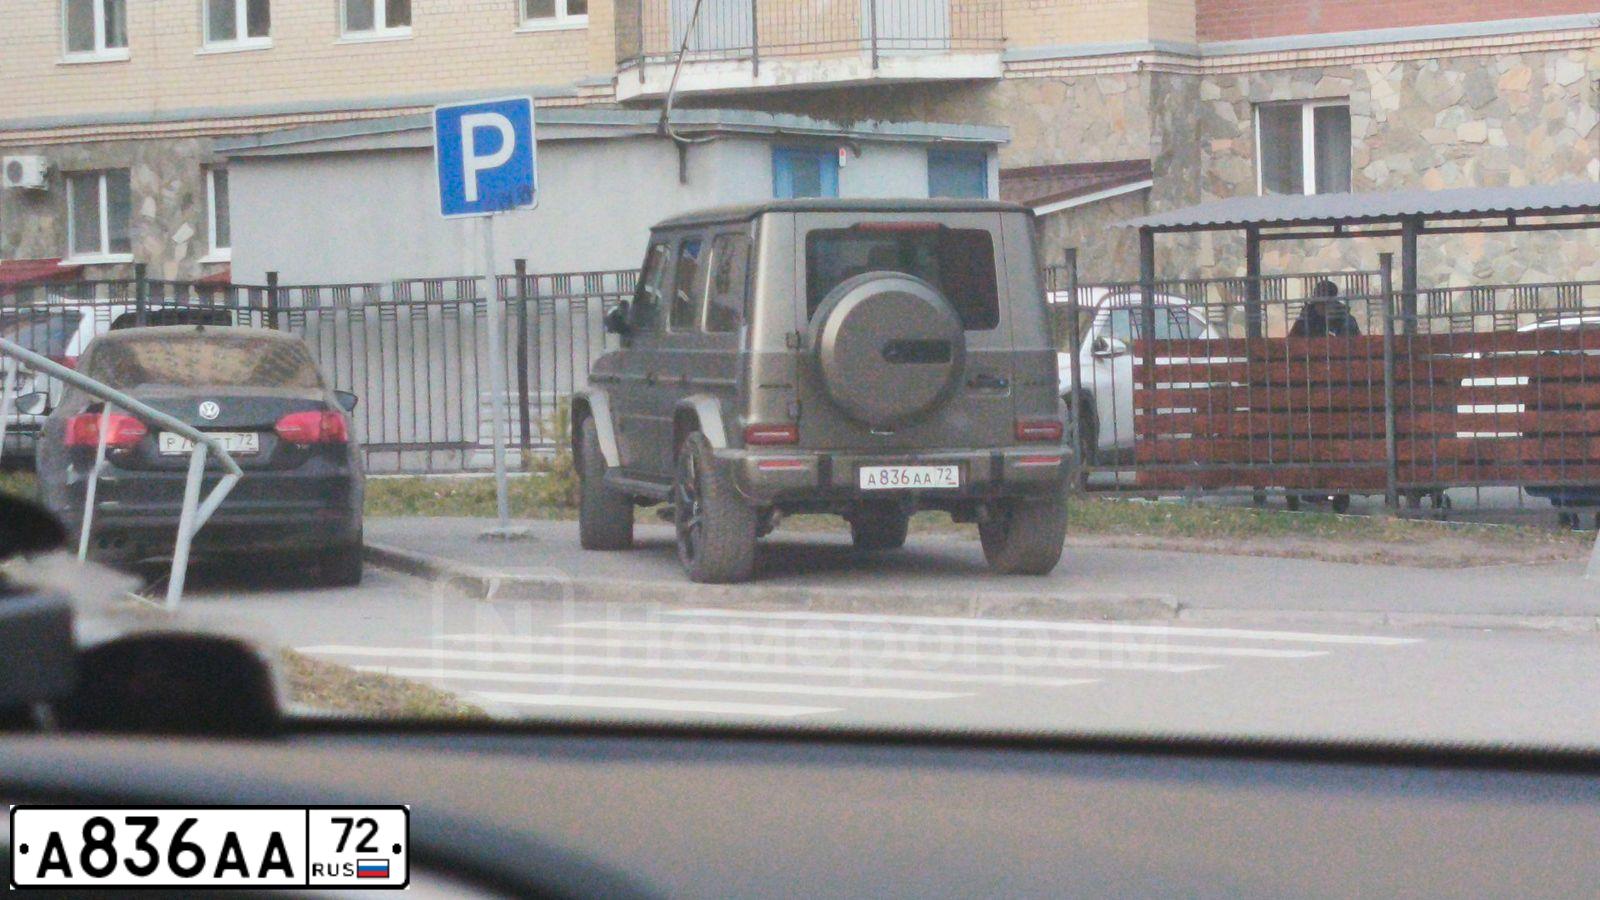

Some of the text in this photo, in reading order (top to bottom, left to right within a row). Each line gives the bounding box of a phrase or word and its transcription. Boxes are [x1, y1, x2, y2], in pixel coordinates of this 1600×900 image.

[461, 112, 516, 203] P
[867, 467, 953, 486] А836АА 72
